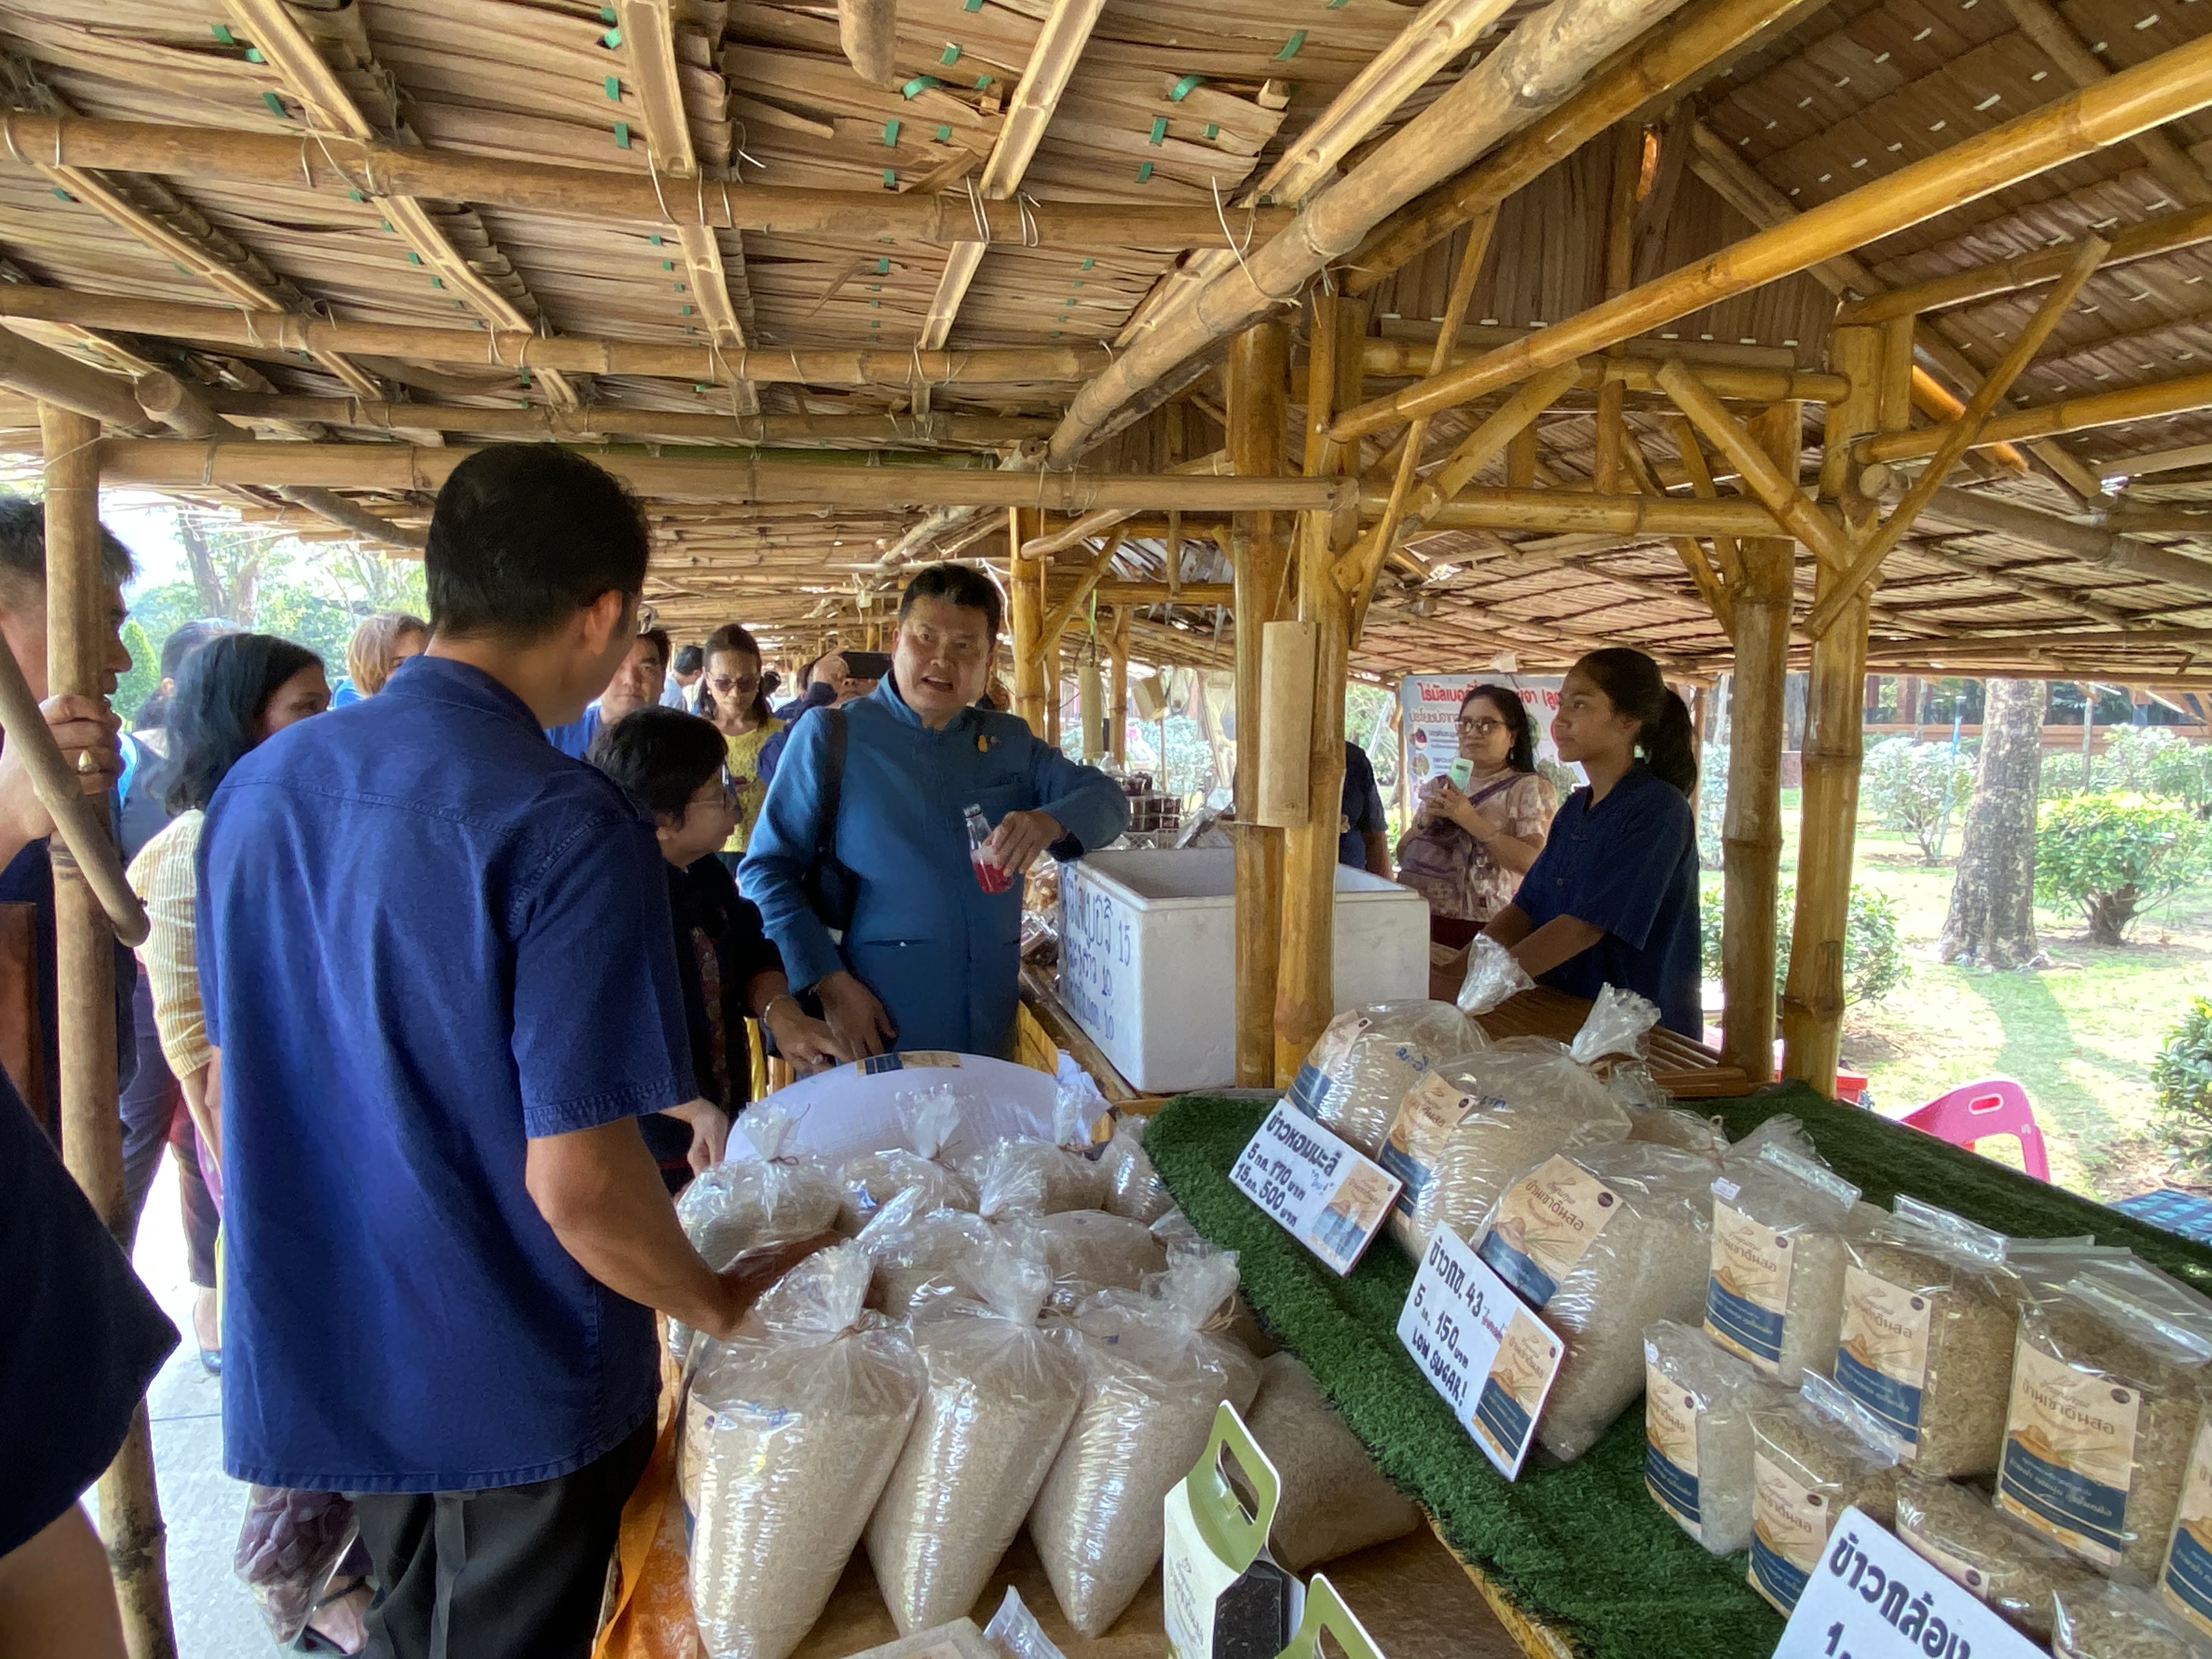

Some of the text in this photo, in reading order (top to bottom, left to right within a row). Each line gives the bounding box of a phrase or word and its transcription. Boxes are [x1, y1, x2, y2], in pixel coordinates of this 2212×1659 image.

[1119, 919, 1131, 966] 15
[1269, 1160, 1293, 1186] 170
[1259, 1180, 1286, 1211] 500
[1414, 1283, 1426, 1307] 5
[1435, 1310, 1460, 1353] 150
[1464, 1282, 1484, 1317] 43
[1412, 1325, 1469, 1407] LOW SUGAR!
[1825, 1620, 1845, 1657] 1
